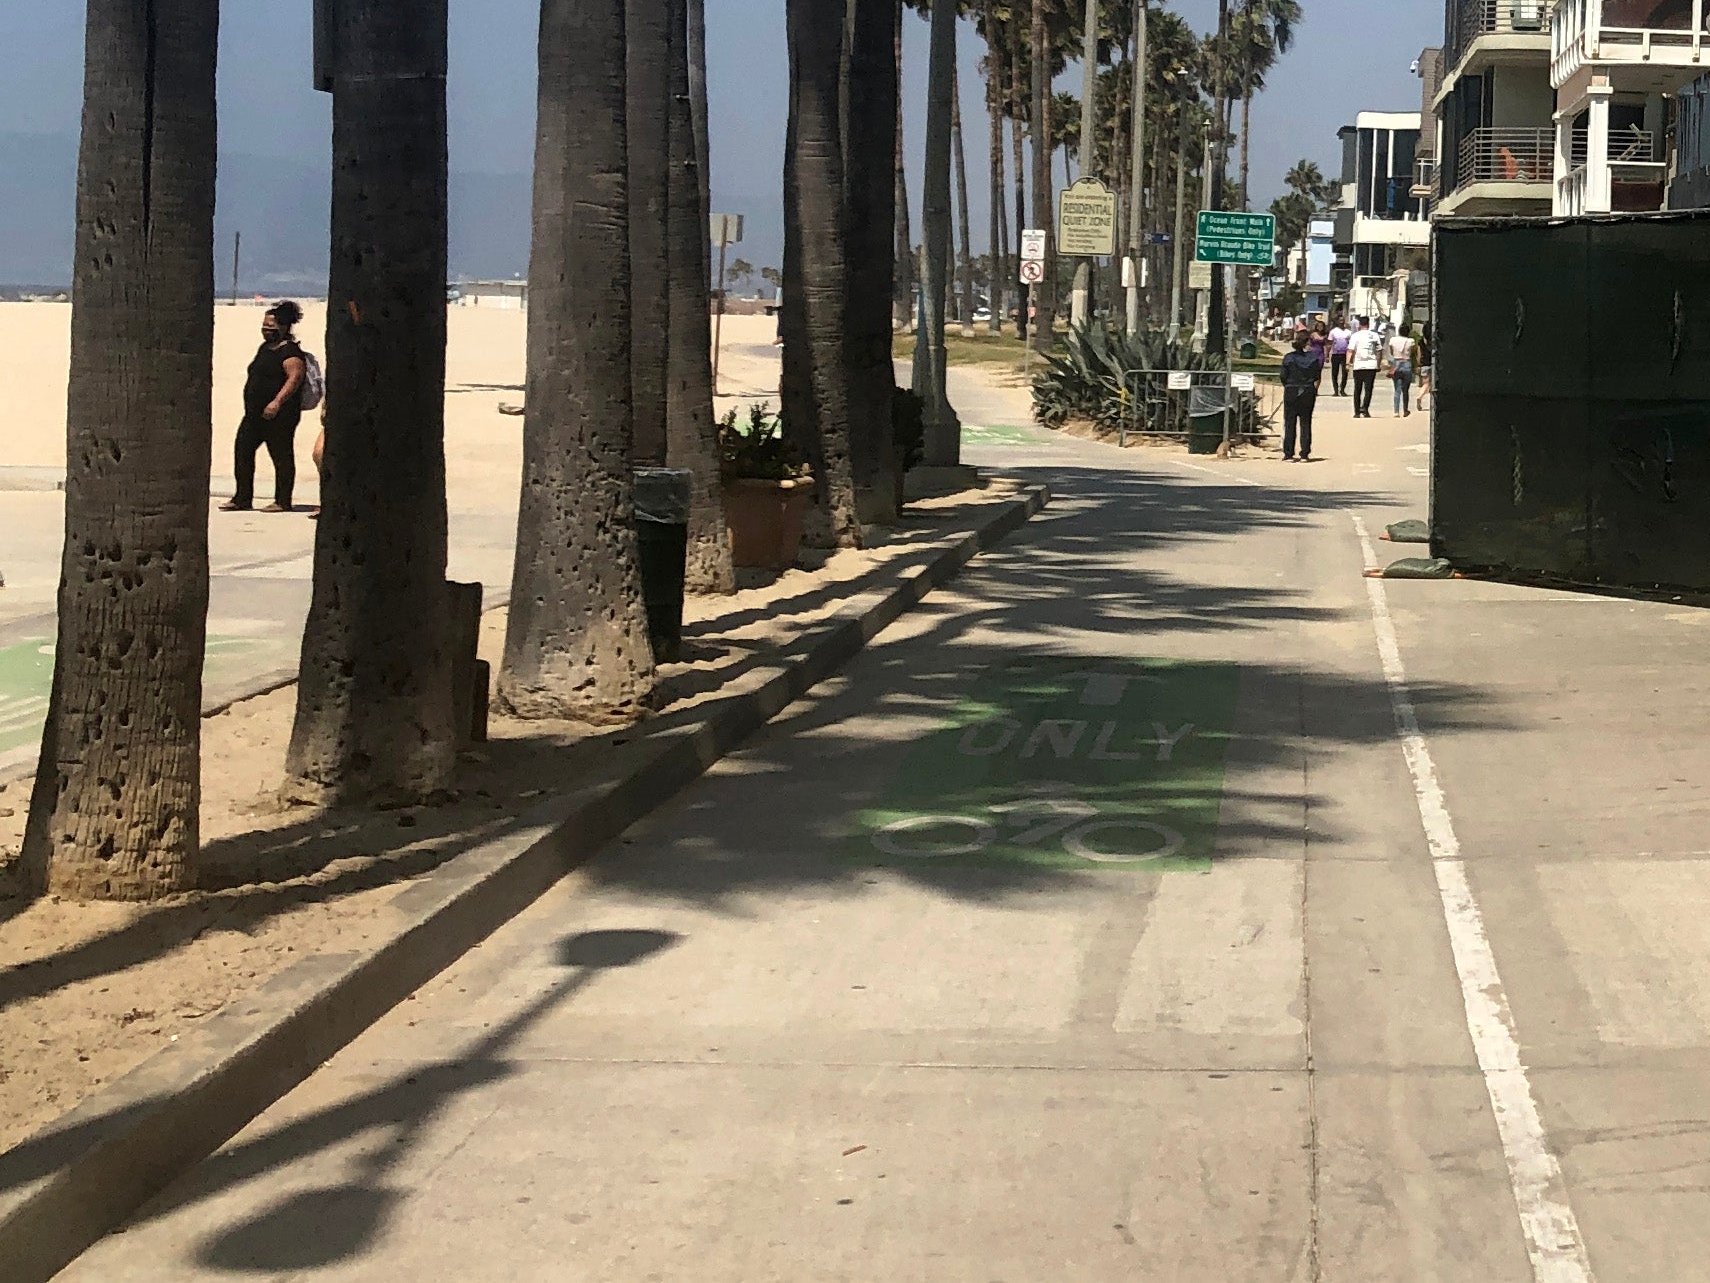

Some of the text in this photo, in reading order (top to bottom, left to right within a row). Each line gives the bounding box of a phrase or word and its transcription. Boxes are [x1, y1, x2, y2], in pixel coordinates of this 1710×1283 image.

[1063, 202, 1112, 216] RESIDENTIAL
[1062, 215, 1112, 227] QUIET ZONE
[957, 719, 1195, 762] ONLY
